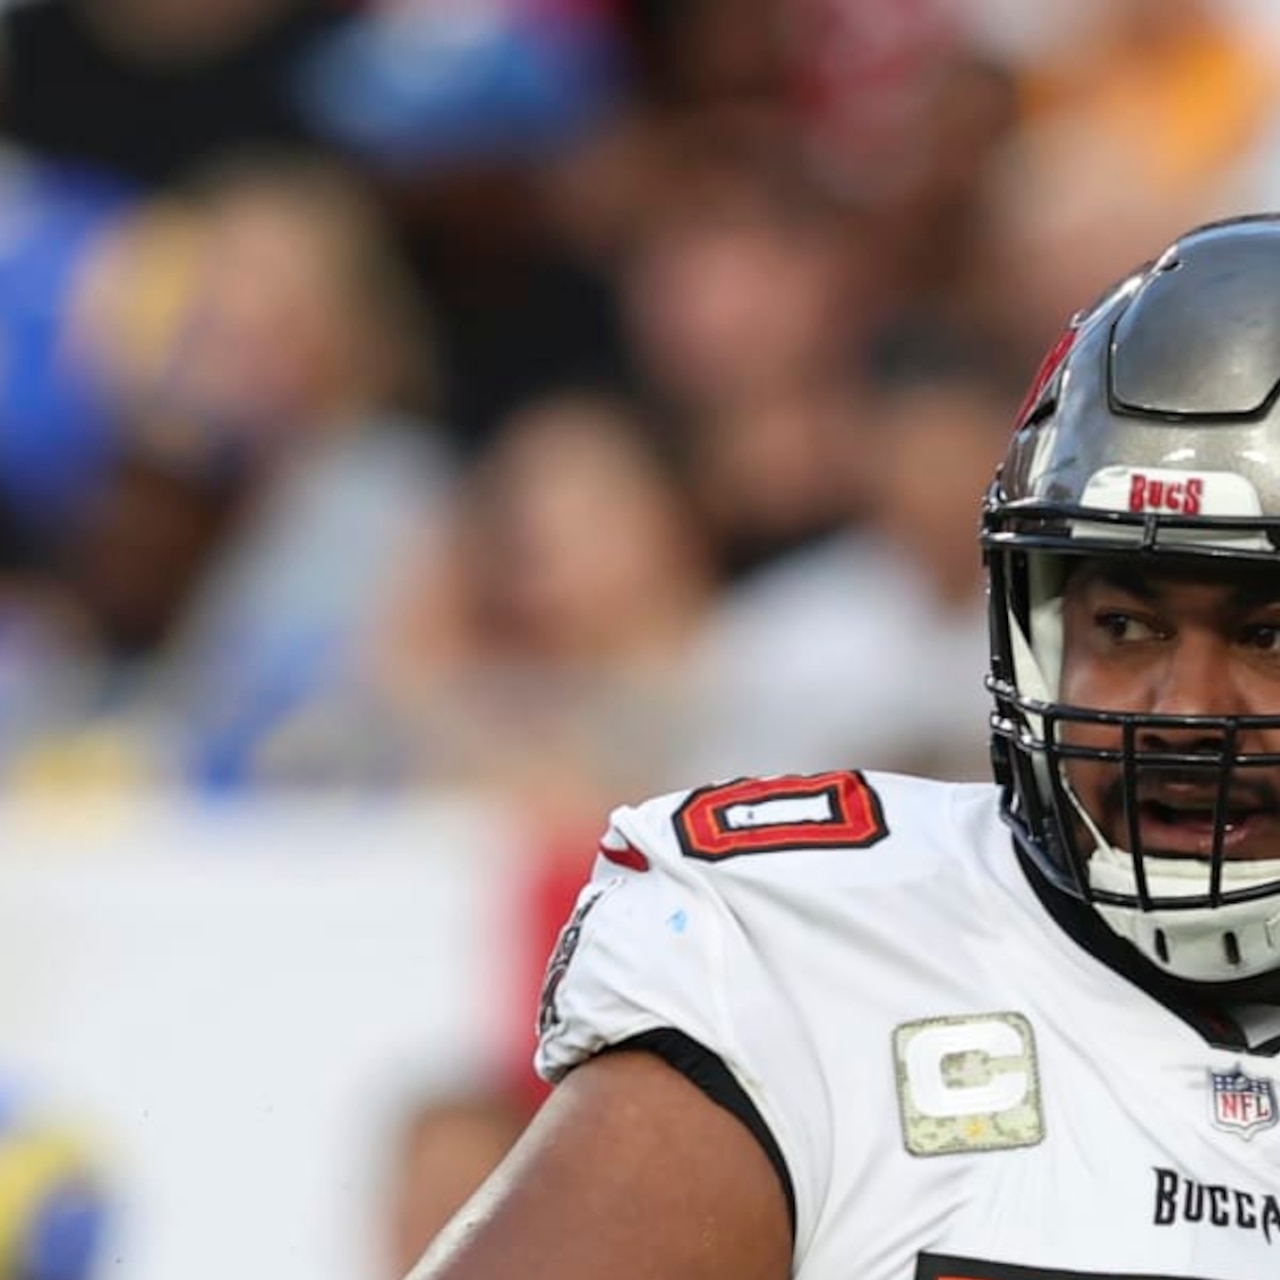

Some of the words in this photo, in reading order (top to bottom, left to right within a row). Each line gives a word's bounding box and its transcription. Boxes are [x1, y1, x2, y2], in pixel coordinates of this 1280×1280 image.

[672, 768, 890, 863] 0
[906, 1023, 1027, 1117] C
[1221, 1091, 1269, 1122] NFL
